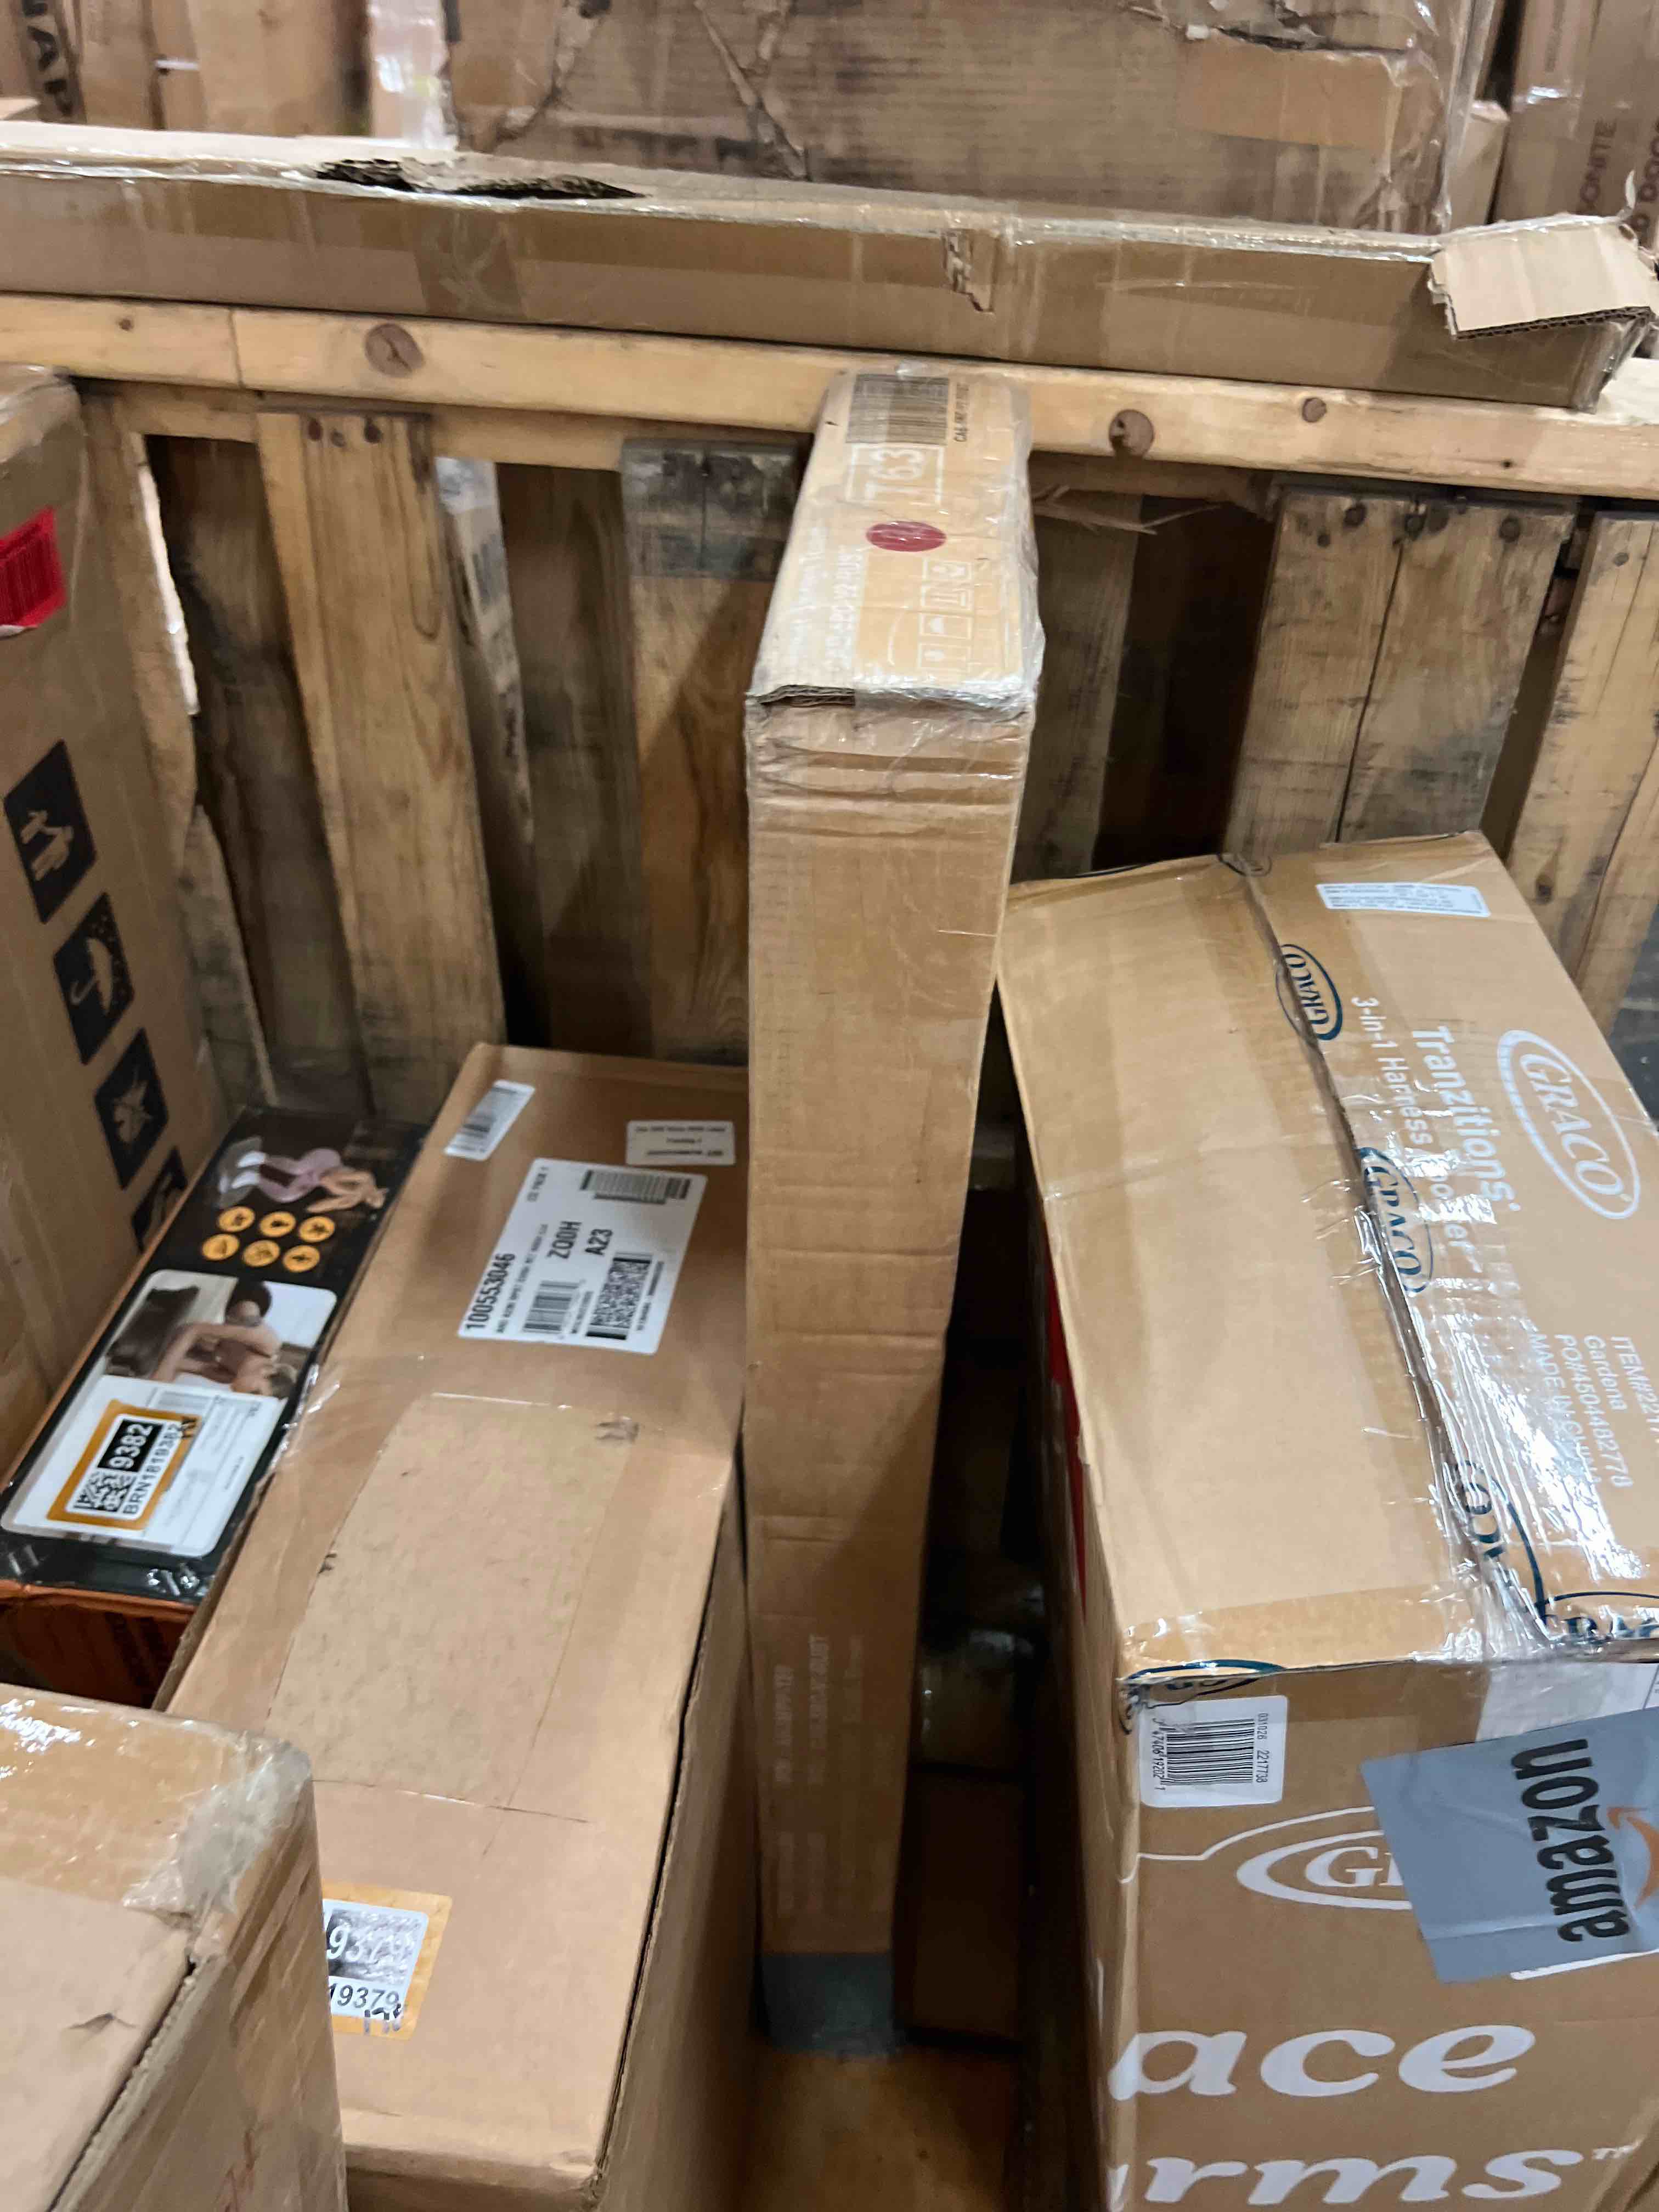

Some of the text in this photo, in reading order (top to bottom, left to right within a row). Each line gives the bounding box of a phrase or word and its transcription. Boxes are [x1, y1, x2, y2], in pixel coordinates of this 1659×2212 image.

[1378, 1057, 1433, 1146] Harness
[1412, 1025, 1516, 1201] Tranzitions
[1520, 1053, 1624, 1195] GRACO
[584, 1228, 613, 1256] A23
[465, 1252, 515, 1329] 100553046
[1584, 1335, 1628, 1410] Gardena
[108, 1423, 154, 1469] 9382
[1256, 1750, 1270, 1783] 2217738
[1511, 1739, 1630, 1942] amazon
[1107, 2148, 1584, 2212] rms
